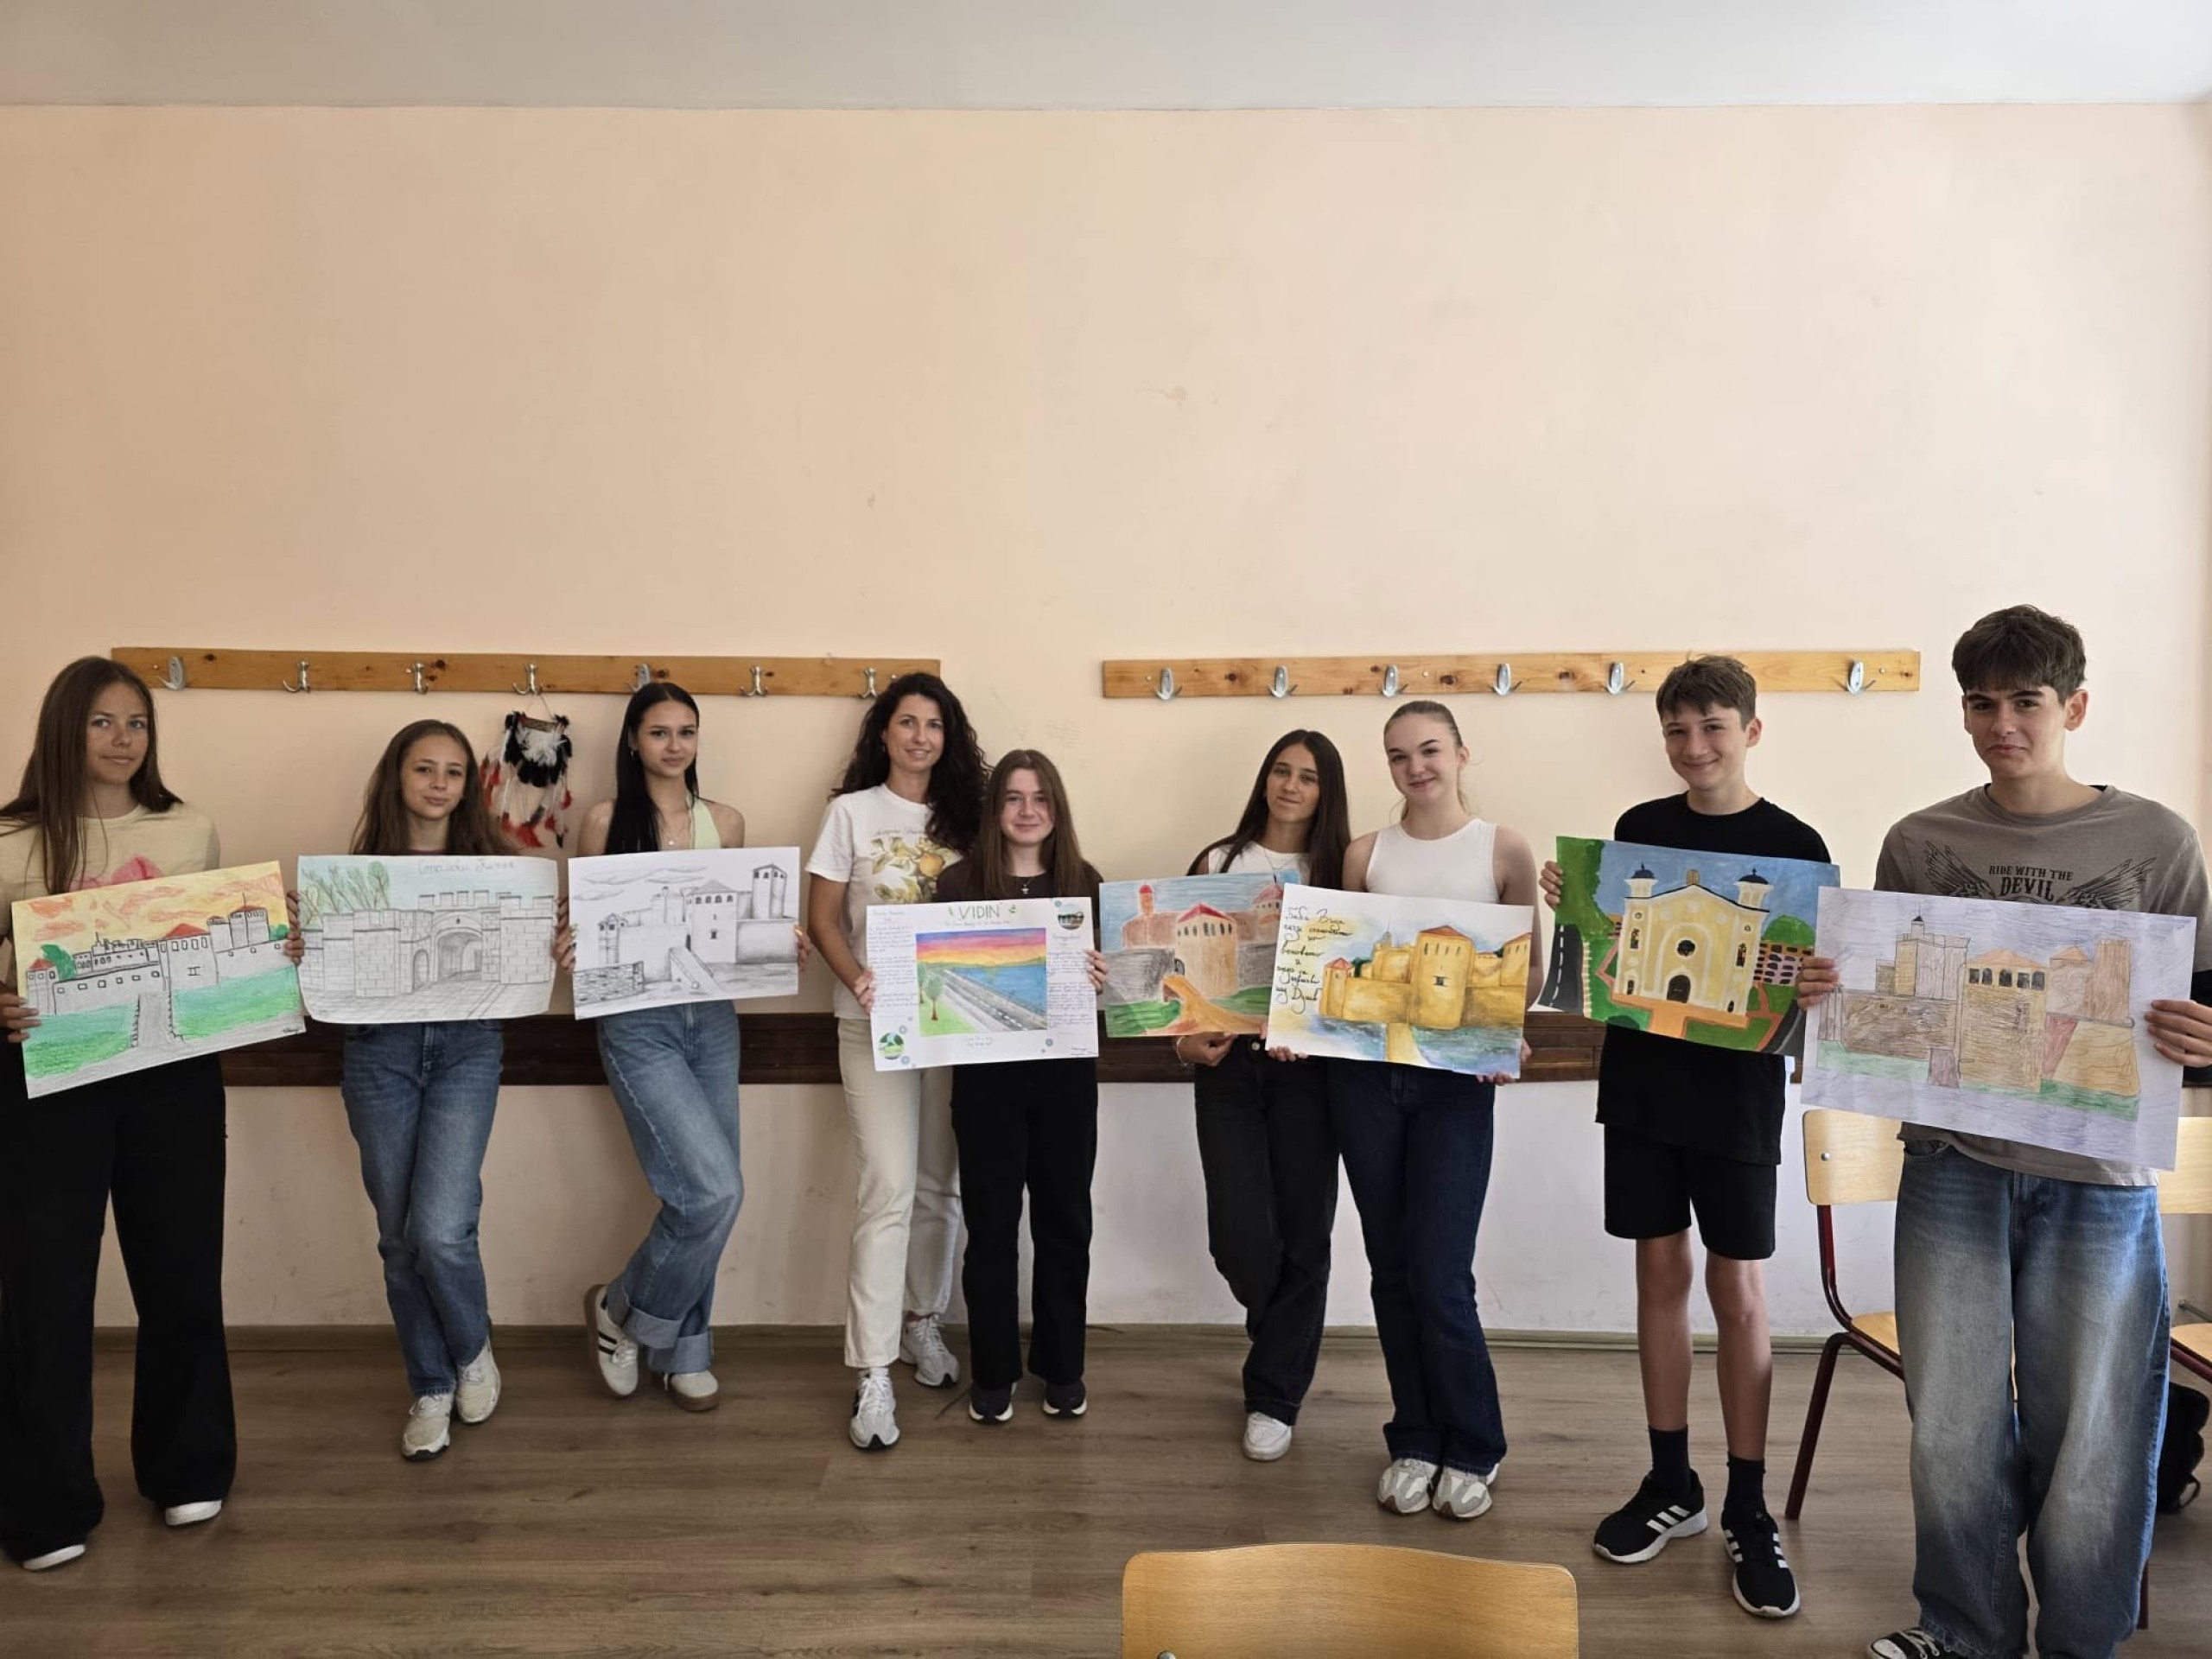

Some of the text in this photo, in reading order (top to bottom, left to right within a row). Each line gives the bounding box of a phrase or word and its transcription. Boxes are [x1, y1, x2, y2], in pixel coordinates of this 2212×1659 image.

[1989, 865, 2074, 881] RIDE WITH THE
[1999, 876, 2054, 901] DEVIL
[957, 904, 1000, 919] VIDIN
